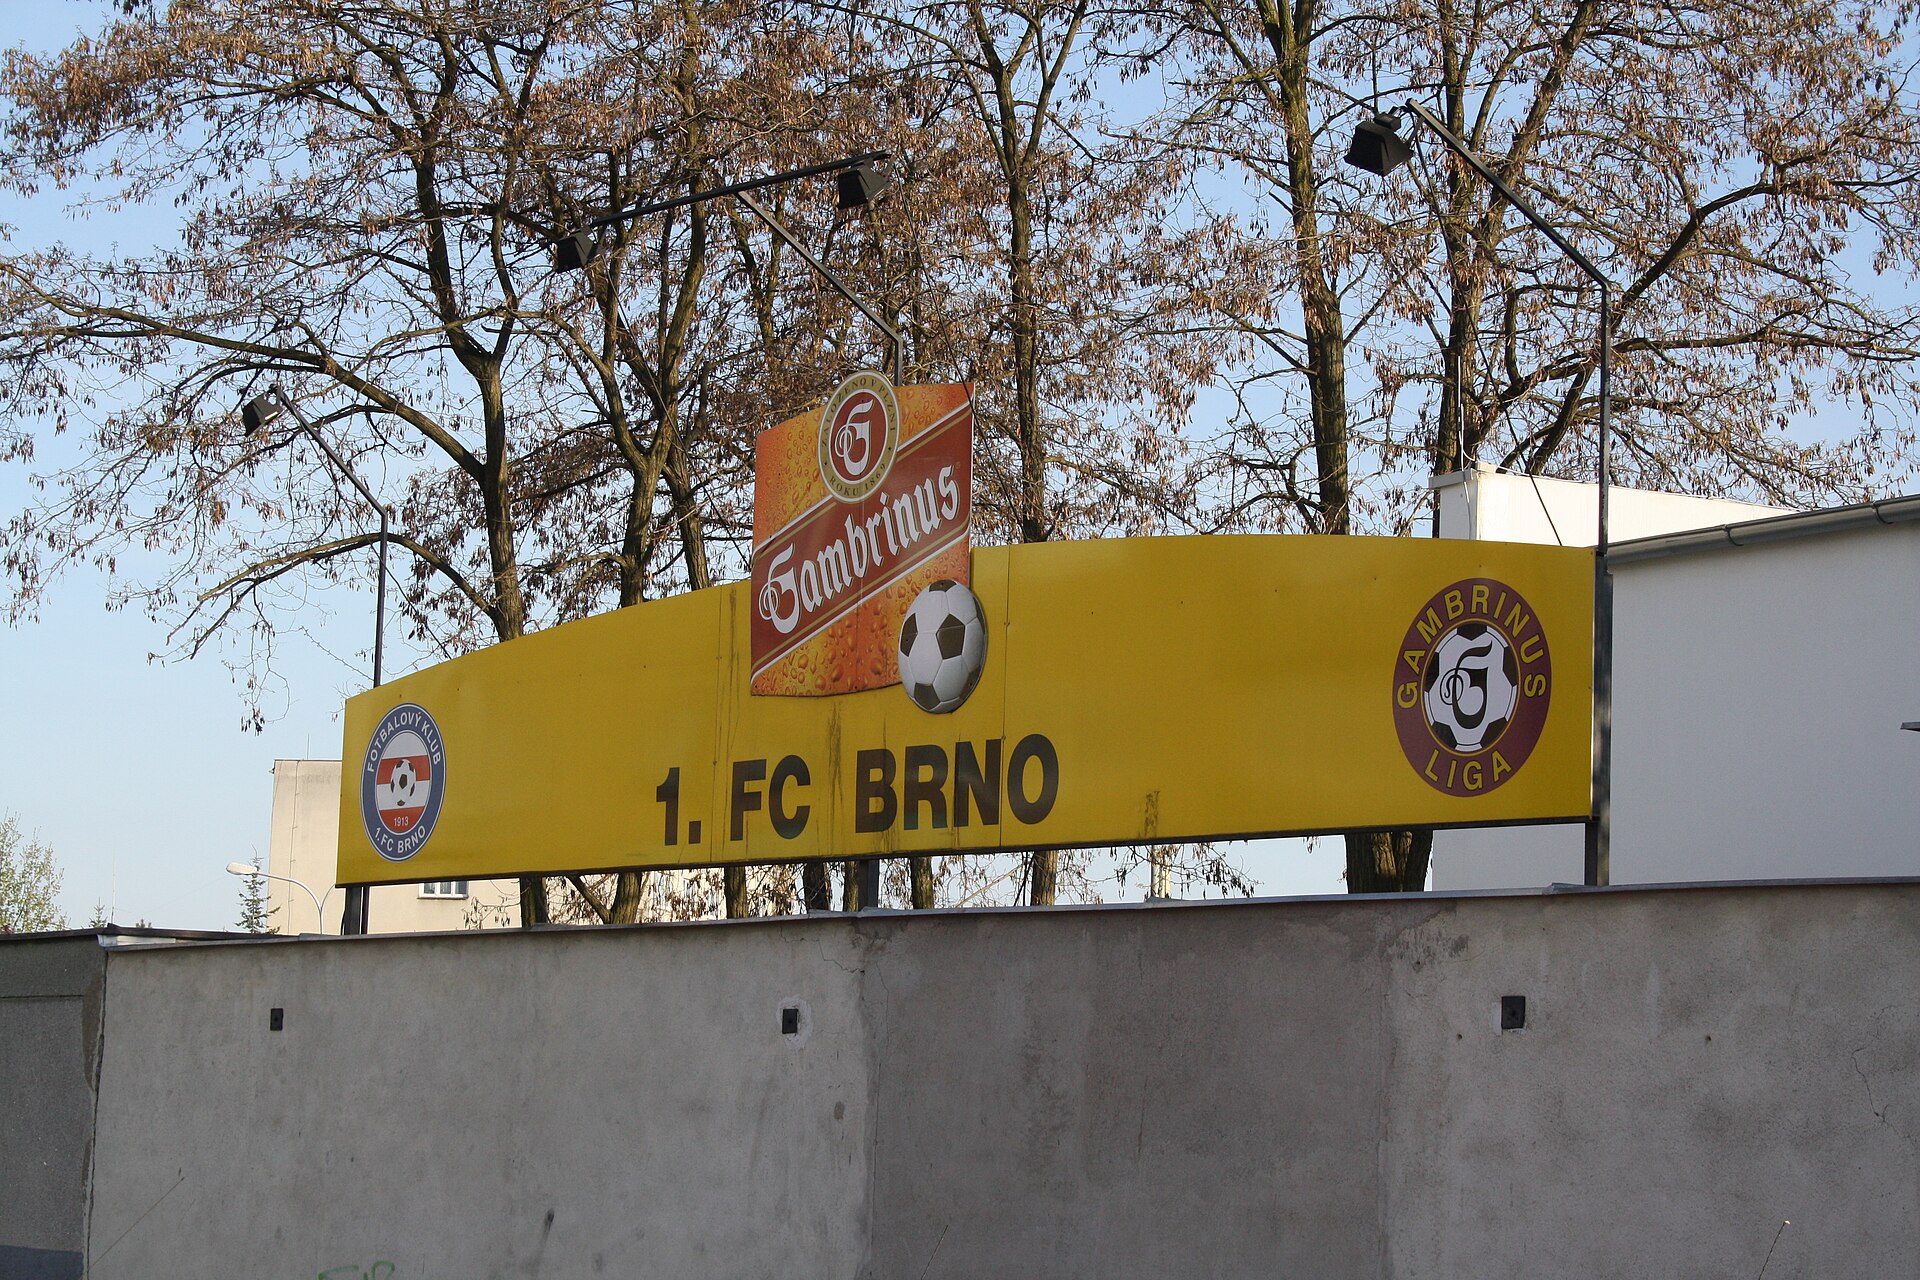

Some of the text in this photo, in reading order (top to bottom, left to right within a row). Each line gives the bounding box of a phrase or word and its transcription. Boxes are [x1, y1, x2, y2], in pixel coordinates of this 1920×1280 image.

[829, 463, 886, 497] ROKU 1869
[758, 464, 961, 635] Gambrinus
[1397, 584, 1547, 709] GAMBRINUS
[367, 711, 441, 772] FOTBALOVÝ KLUB
[656, 733, 1060, 846] 1. FC BRNO
[1424, 749, 1512, 791] LIGA
[393, 816, 409, 827] 1913
[397, 825, 426, 854] BRNO
